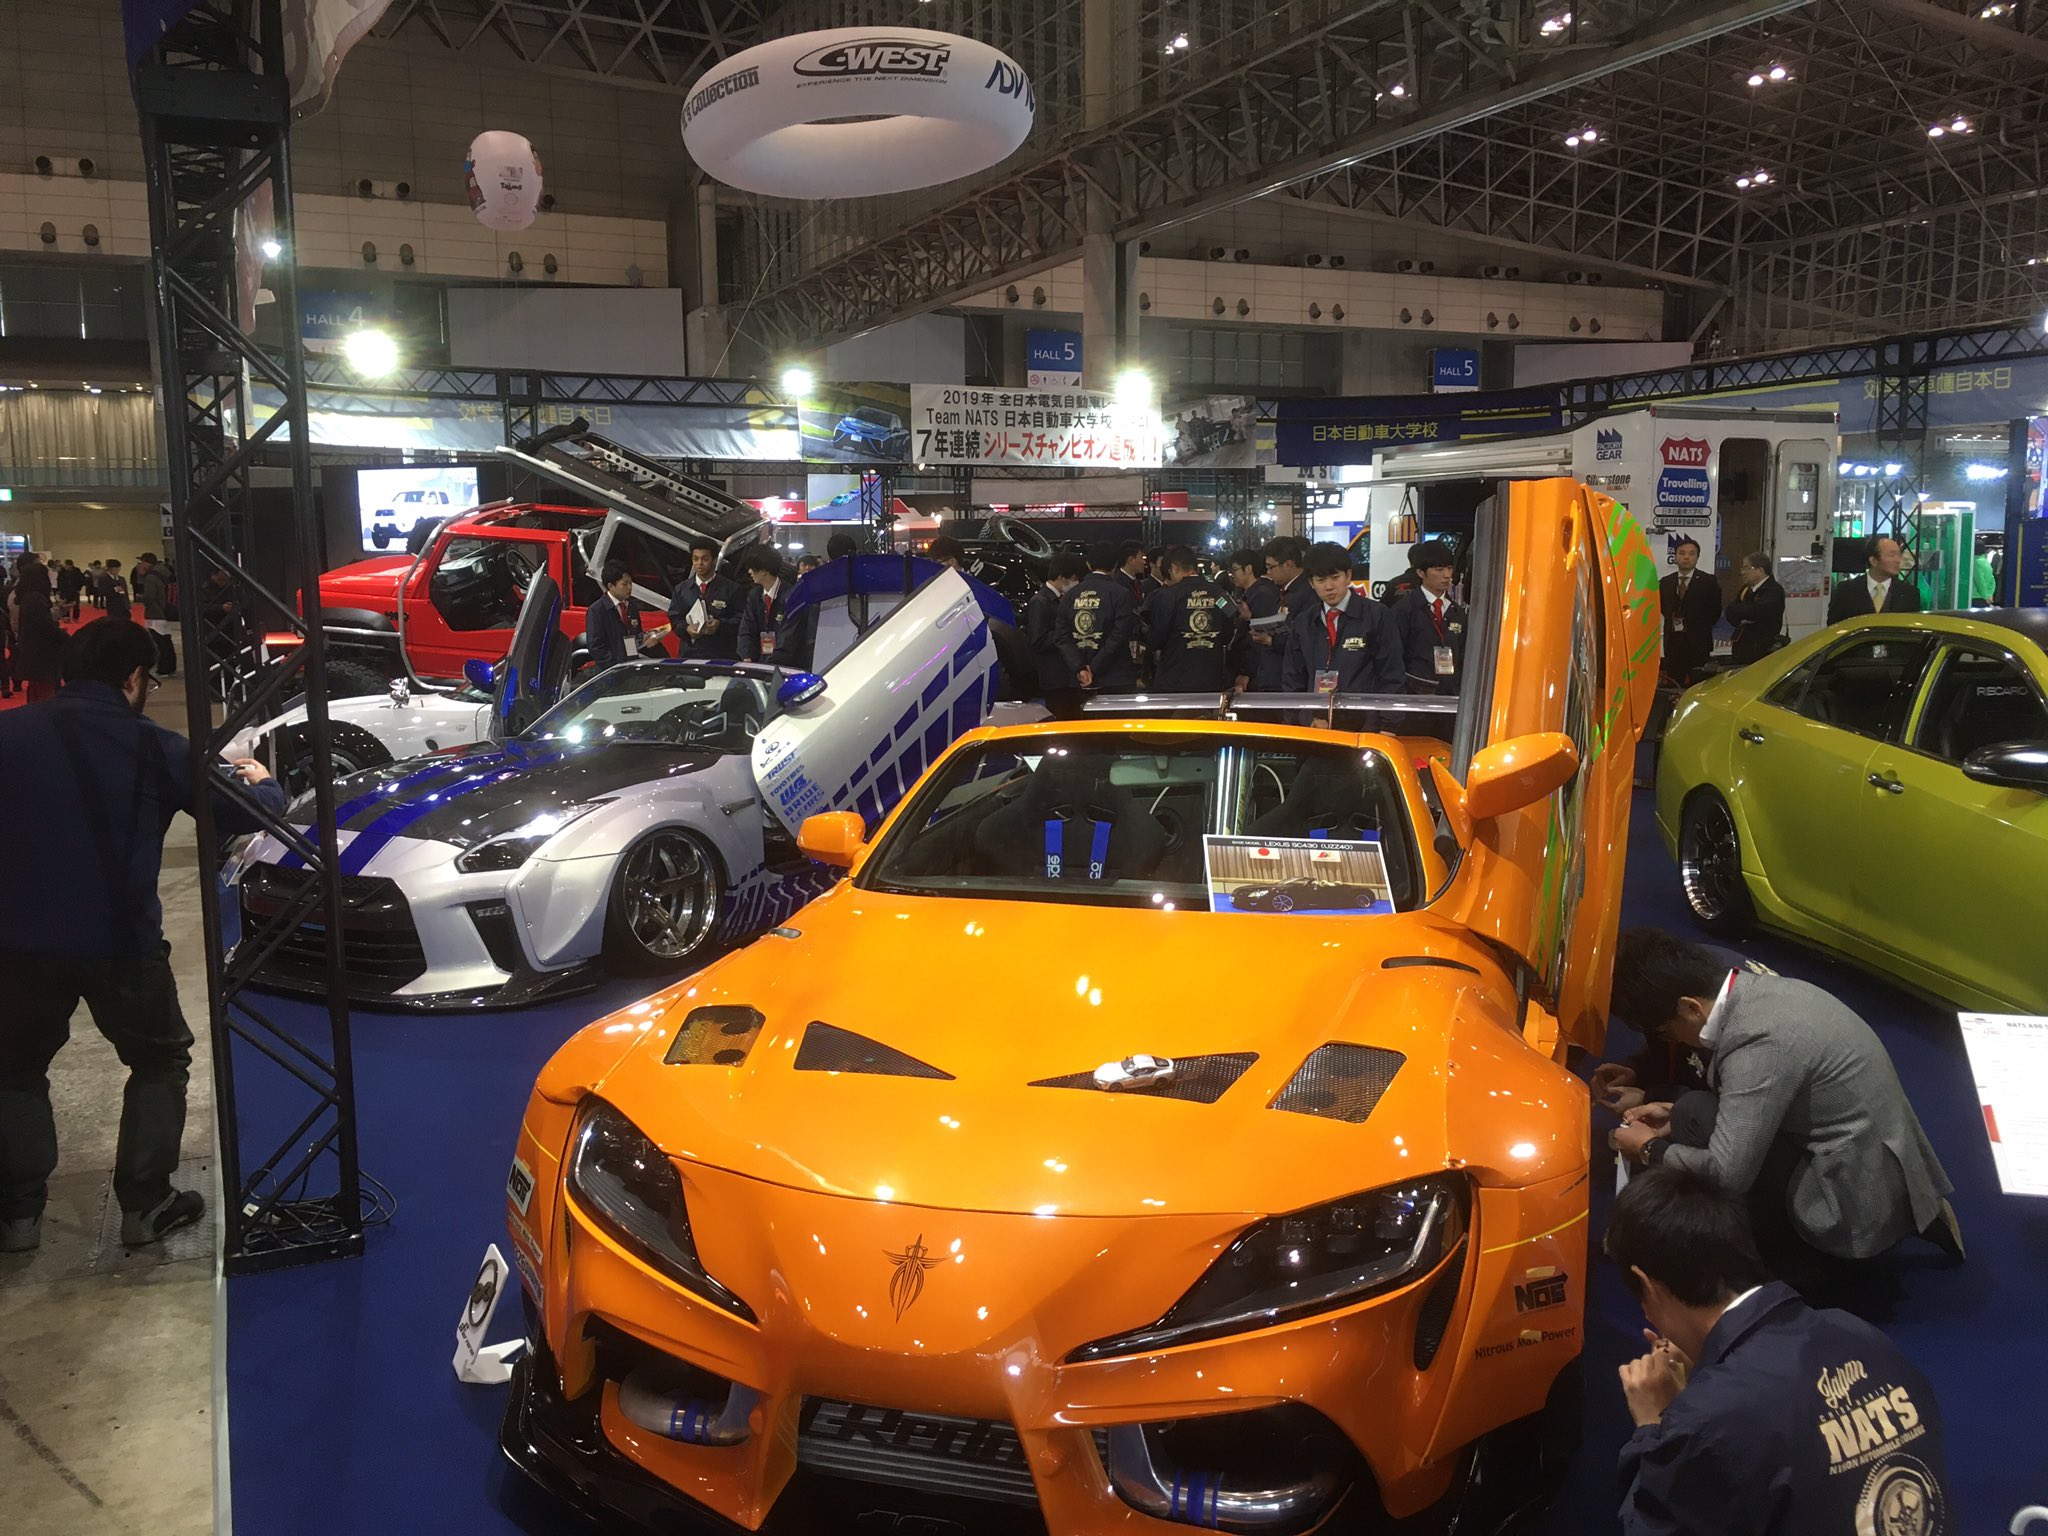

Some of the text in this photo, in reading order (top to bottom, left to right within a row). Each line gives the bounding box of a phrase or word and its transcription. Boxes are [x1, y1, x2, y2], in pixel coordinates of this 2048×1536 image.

[796, 78, 851, 88] EXPERIENCE
[306, 305, 366, 332] HALL 4
[1034, 342, 1075, 361] HALL 5
[1440, 359, 1473, 376] HALL 5
[943, 390, 994, 406] 2019年
[926, 408, 960, 425] Team
[965, 409, 999, 426] NATS
[1312, 422, 1439, 442] 日本自動車大学校
[1596, 450, 1622, 461] GEAR
[1668, 445, 1703, 462] NATS
[1662, 477, 1708, 491] Travelling
[1659, 491, 1705, 503] Classroom
[1074, 598, 1100, 608] NATS
[1187, 598, 1216, 607] NATS
[1514, 1272, 1569, 1313] NOS
[1474, 1326, 1576, 1360] Nitrous Max Power
[1819, 1385, 1919, 1464] NATS
